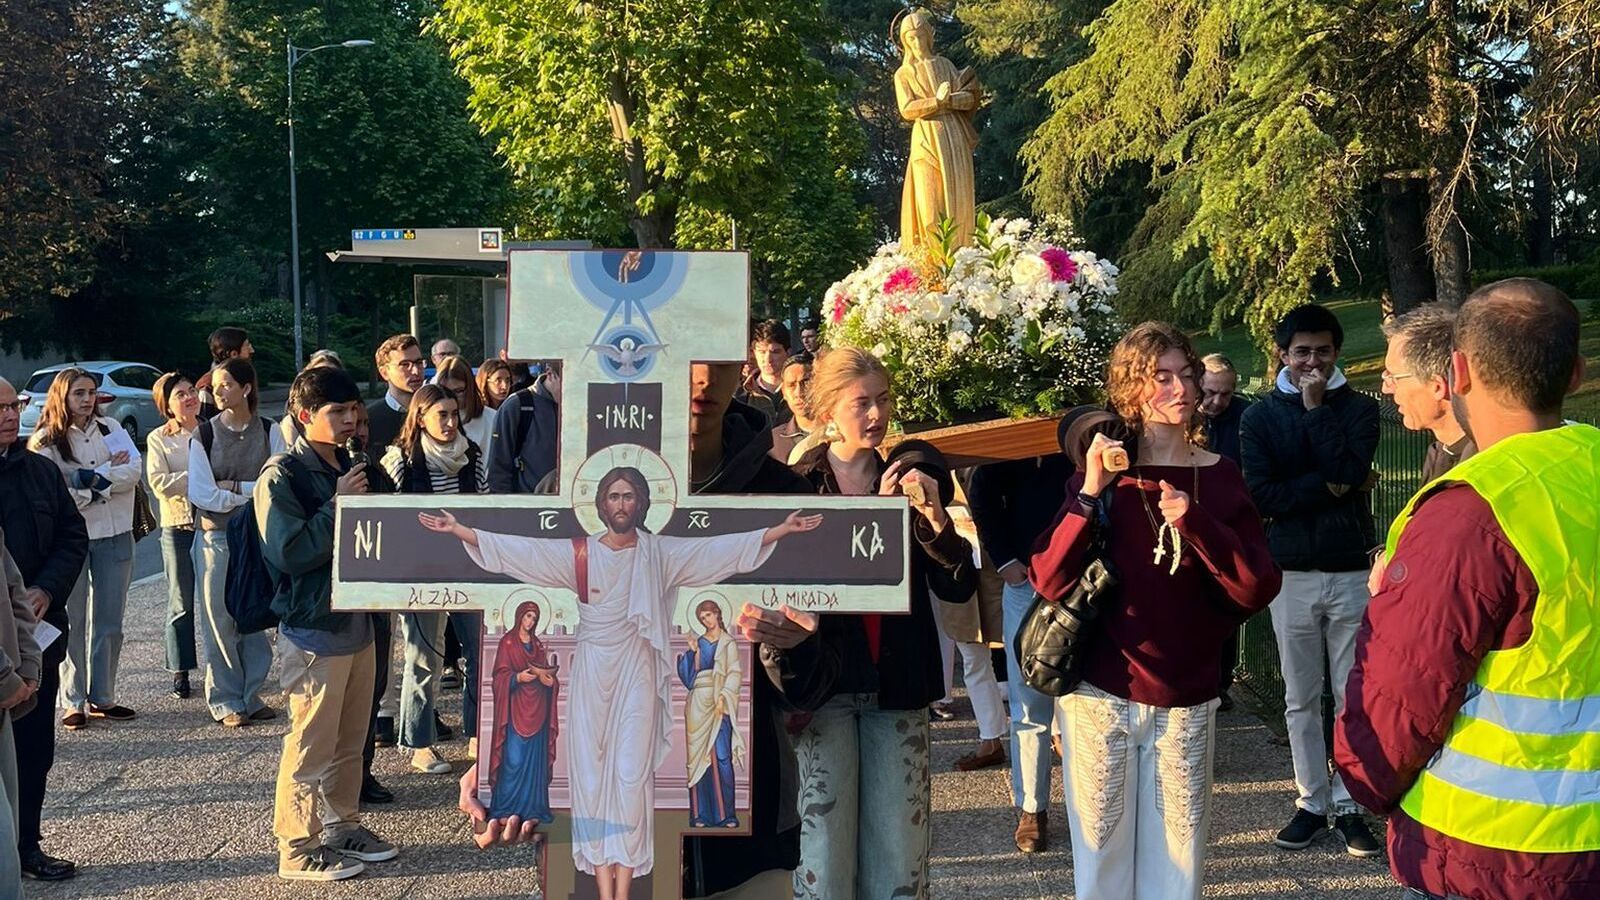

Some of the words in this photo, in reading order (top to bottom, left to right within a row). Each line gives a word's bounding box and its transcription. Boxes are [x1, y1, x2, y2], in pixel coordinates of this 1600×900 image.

[354, 520, 383, 561] NI
[851, 521, 885, 561] KA
[408, 587, 470, 608] ALZAD
[761, 587, 779, 607] LA
[786, 589, 840, 610] MIRADA
